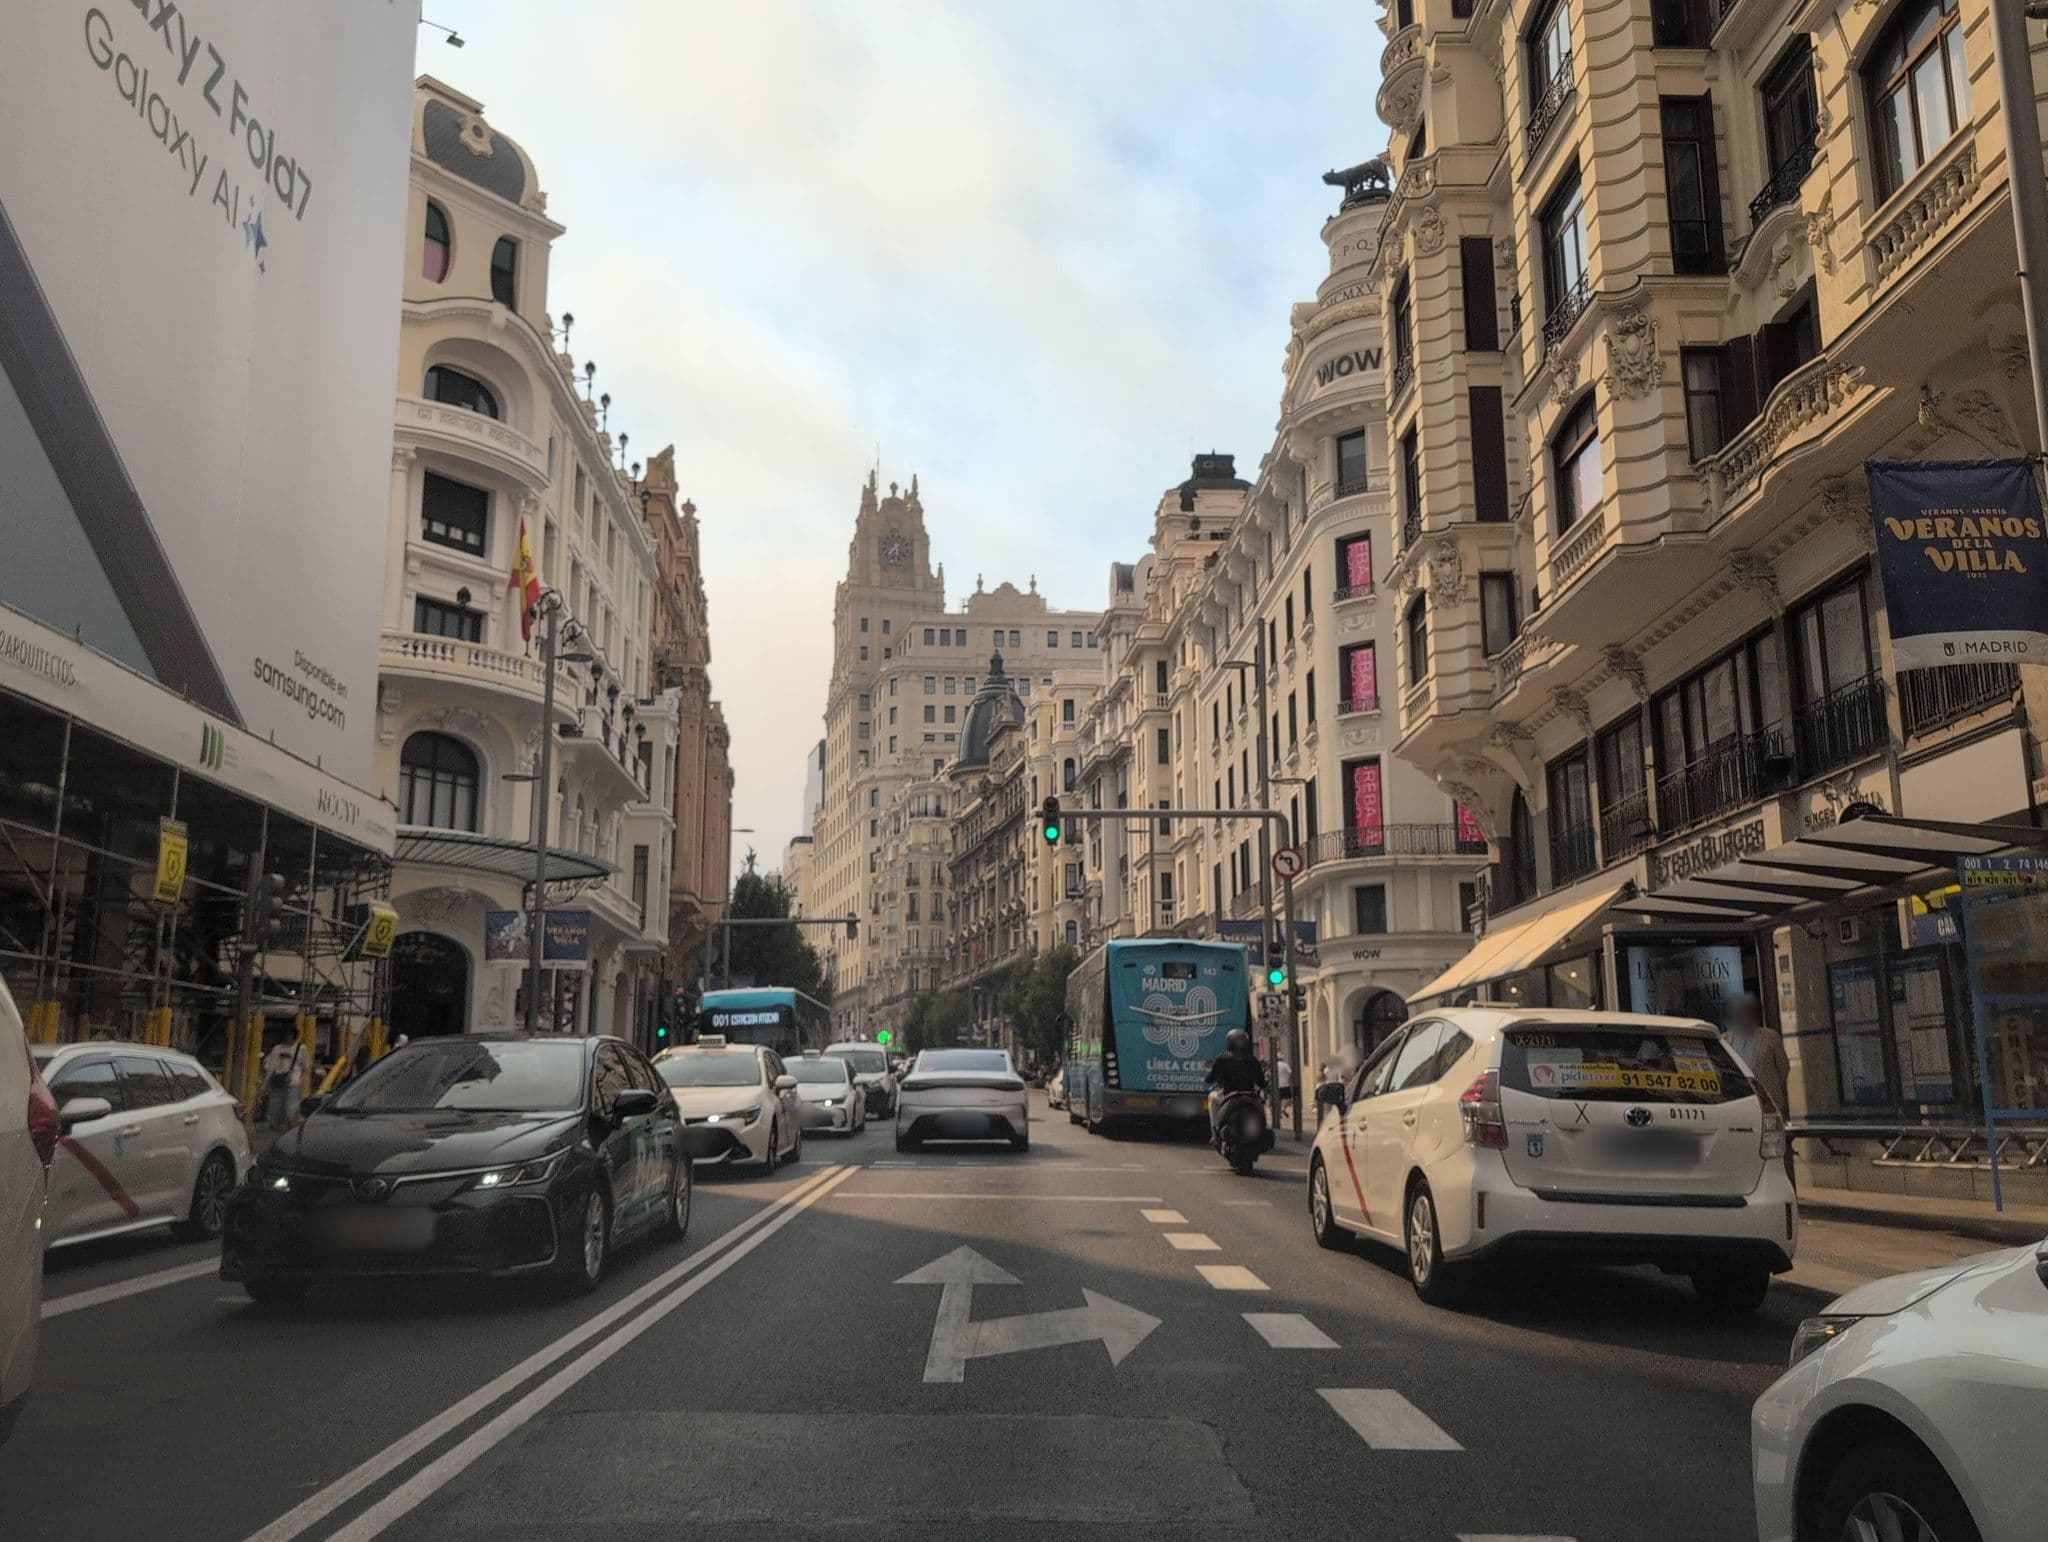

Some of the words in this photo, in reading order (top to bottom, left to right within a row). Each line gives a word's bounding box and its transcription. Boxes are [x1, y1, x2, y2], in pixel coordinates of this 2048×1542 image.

[203, 42, 231, 117] Z
[84, 8, 209, 197] Galaxy
[212, 168, 240, 230] AI
[1316, 347, 1383, 388] WOW
[1884, 516, 2041, 541] VERANOS
[1952, 538, 1973, 549] DE
[1974, 538, 1993, 549] LA
[1924, 546, 2028, 574] VILLA
[1965, 641, 2029, 654] MADRID
[254, 657, 346, 732] samsung.com
[1986, 858, 1992, 869] 1
[1352, 949, 1381, 960] WOW
[1142, 977, 1187, 992] MADRID
[712, 1014, 729, 1027] 001
[1142, 986, 1217, 1058] 360
[1146, 1057, 1180, 1071] LÍNEA
[1621, 1072, 1640, 1086] 91
[1645, 1073, 1671, 1088] 547
[1678, 1076, 1696, 1090] 82
[1700, 1078, 1719, 1092] 00
[1574, 1103, 1590, 1125] X
[1669, 1108, 1706, 1121] 01171
